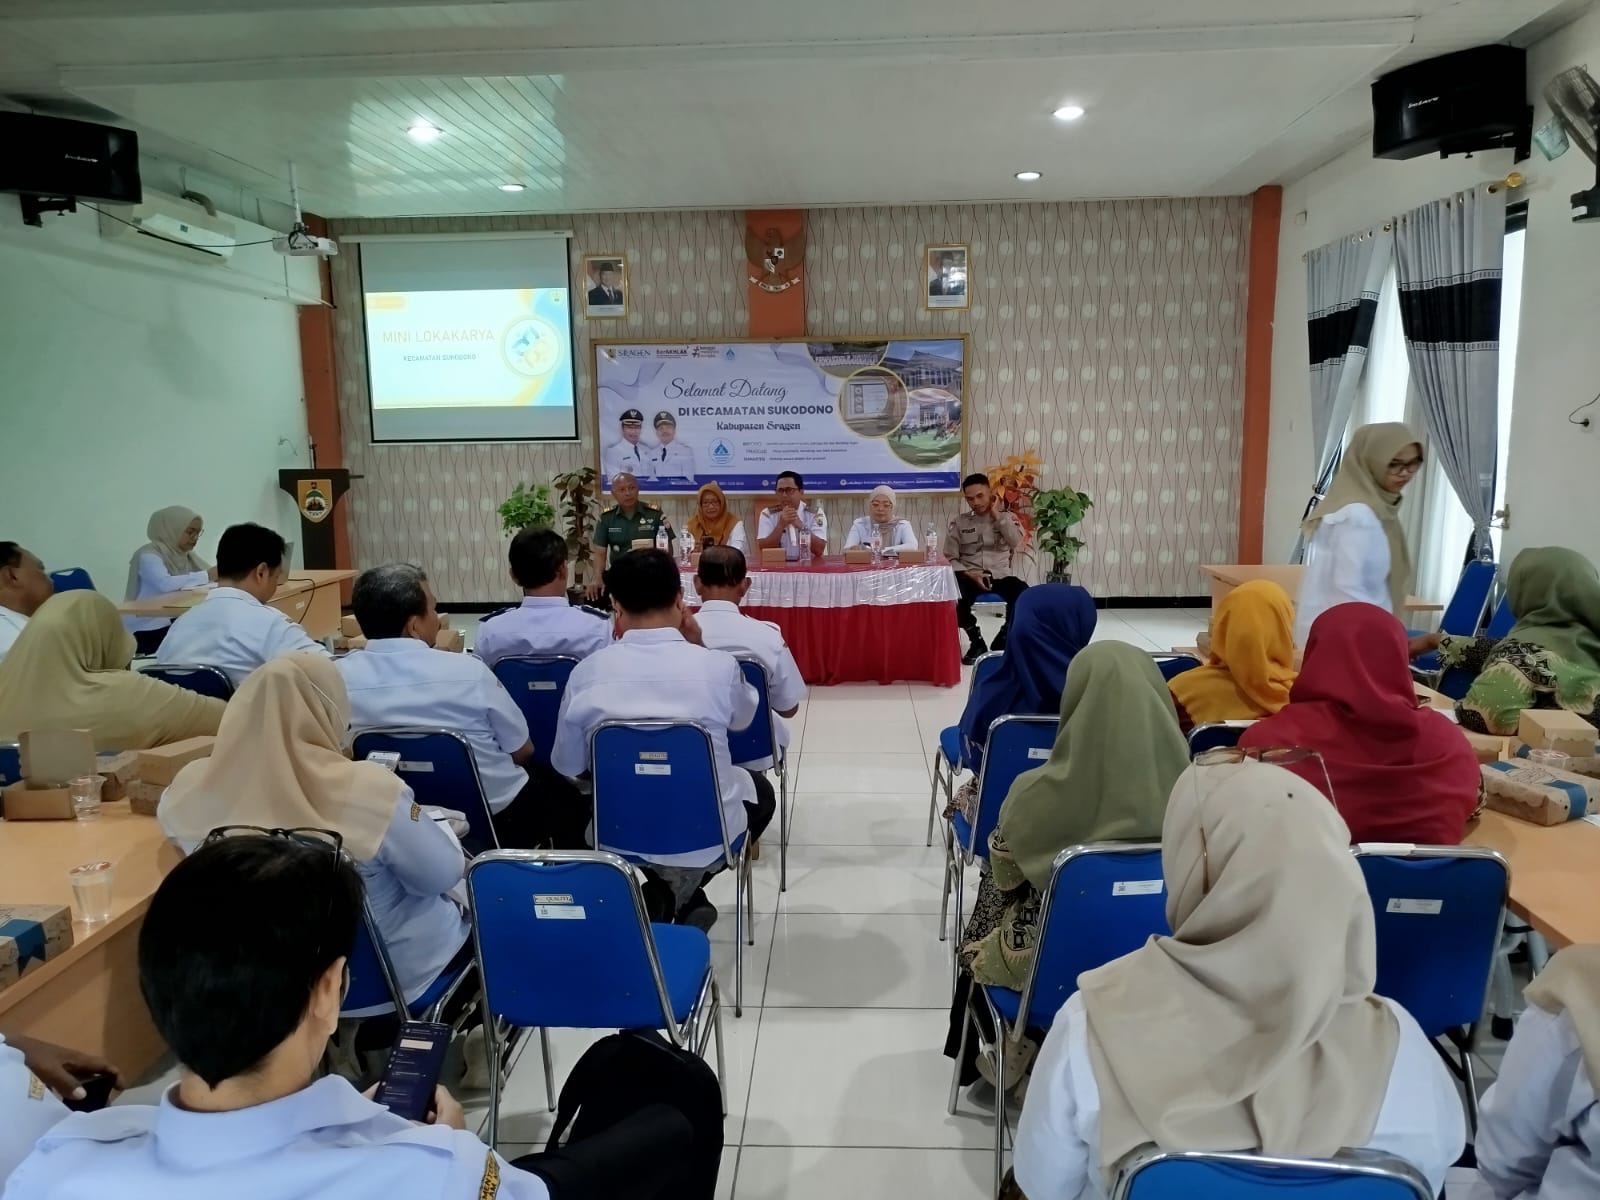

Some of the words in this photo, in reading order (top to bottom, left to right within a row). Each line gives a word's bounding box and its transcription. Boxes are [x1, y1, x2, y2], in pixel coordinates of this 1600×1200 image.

[383, 330, 411, 343] MINI
[416, 328, 495, 343] LOKAKARYA
[403, 354, 441, 362] KECAMATAN
[664, 377, 727, 399] Selamat
[729, 378, 788, 402] Datang
[678, 407, 690, 416] DI
[691, 406, 766, 416] KECAMATAN
[767, 405, 834, 415] SUKODONO
[716, 421, 765, 432] Kabupaten
[766, 420, 801, 431] Sragen
